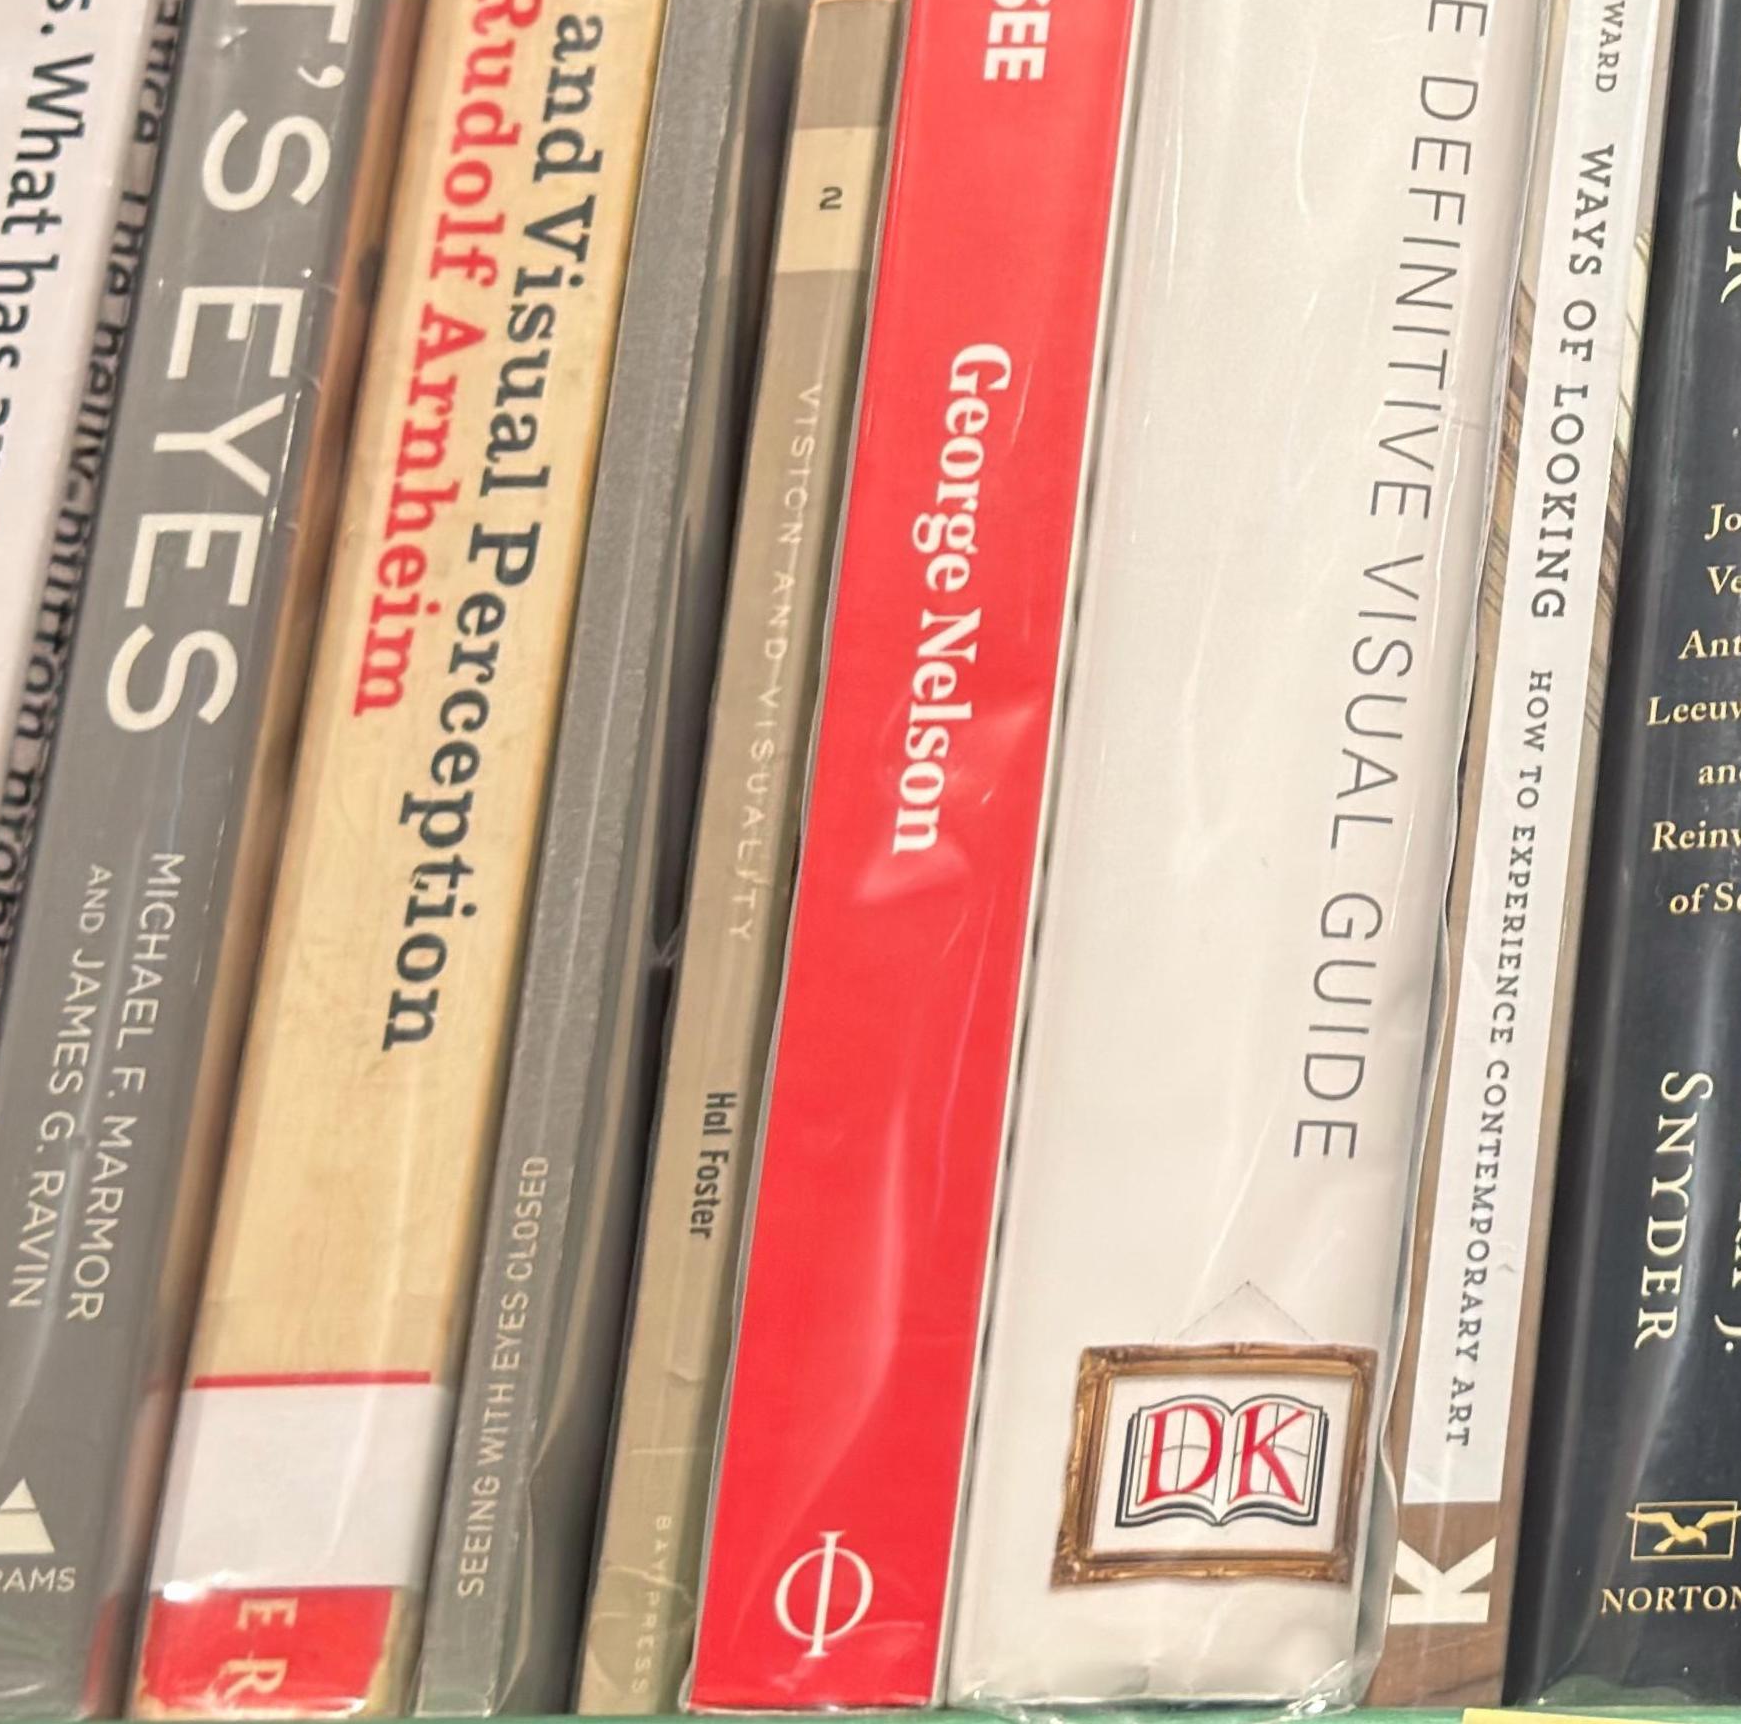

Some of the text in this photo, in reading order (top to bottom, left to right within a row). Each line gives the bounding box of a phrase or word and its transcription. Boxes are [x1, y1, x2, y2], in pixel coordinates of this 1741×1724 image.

[532, 18, 606, 182] and
[1594, 0, 1628, 95] WARD
[469, 192, 594, 495] Visual
[1370, 77, 1479, 522] DEFINITIVE
[1529, 144, 1616, 620] WAYS OF LOOKING
[107, 285, 304, 731] EYES
[353, 303, 488, 717] Arnheim
[893, 343, 1012, 855] George Nelson
[1328, 553, 1425, 850] VISUAL
[382, 521, 541, 1050] Perception
[1669, 884, 1709, 914] of
[9, 865, 112, 1308] AND JAMES G. RAVIN
[66, 850, 186, 1320] MICHAEL F. MARMOR
[688, 1092, 736, 1240] Hal Foster
[1292, 893, 1385, 1161] GUIDE
[1444, 671, 1552, 1447] HOW TO EXPERIENCE CONTEMPORARY ART
[1634, 1073, 1714, 1350] SNYDER
[458, 1156, 549, 1598] SEEING WITH EYES CLOSED
[1139, 1403, 1306, 1507] DK
